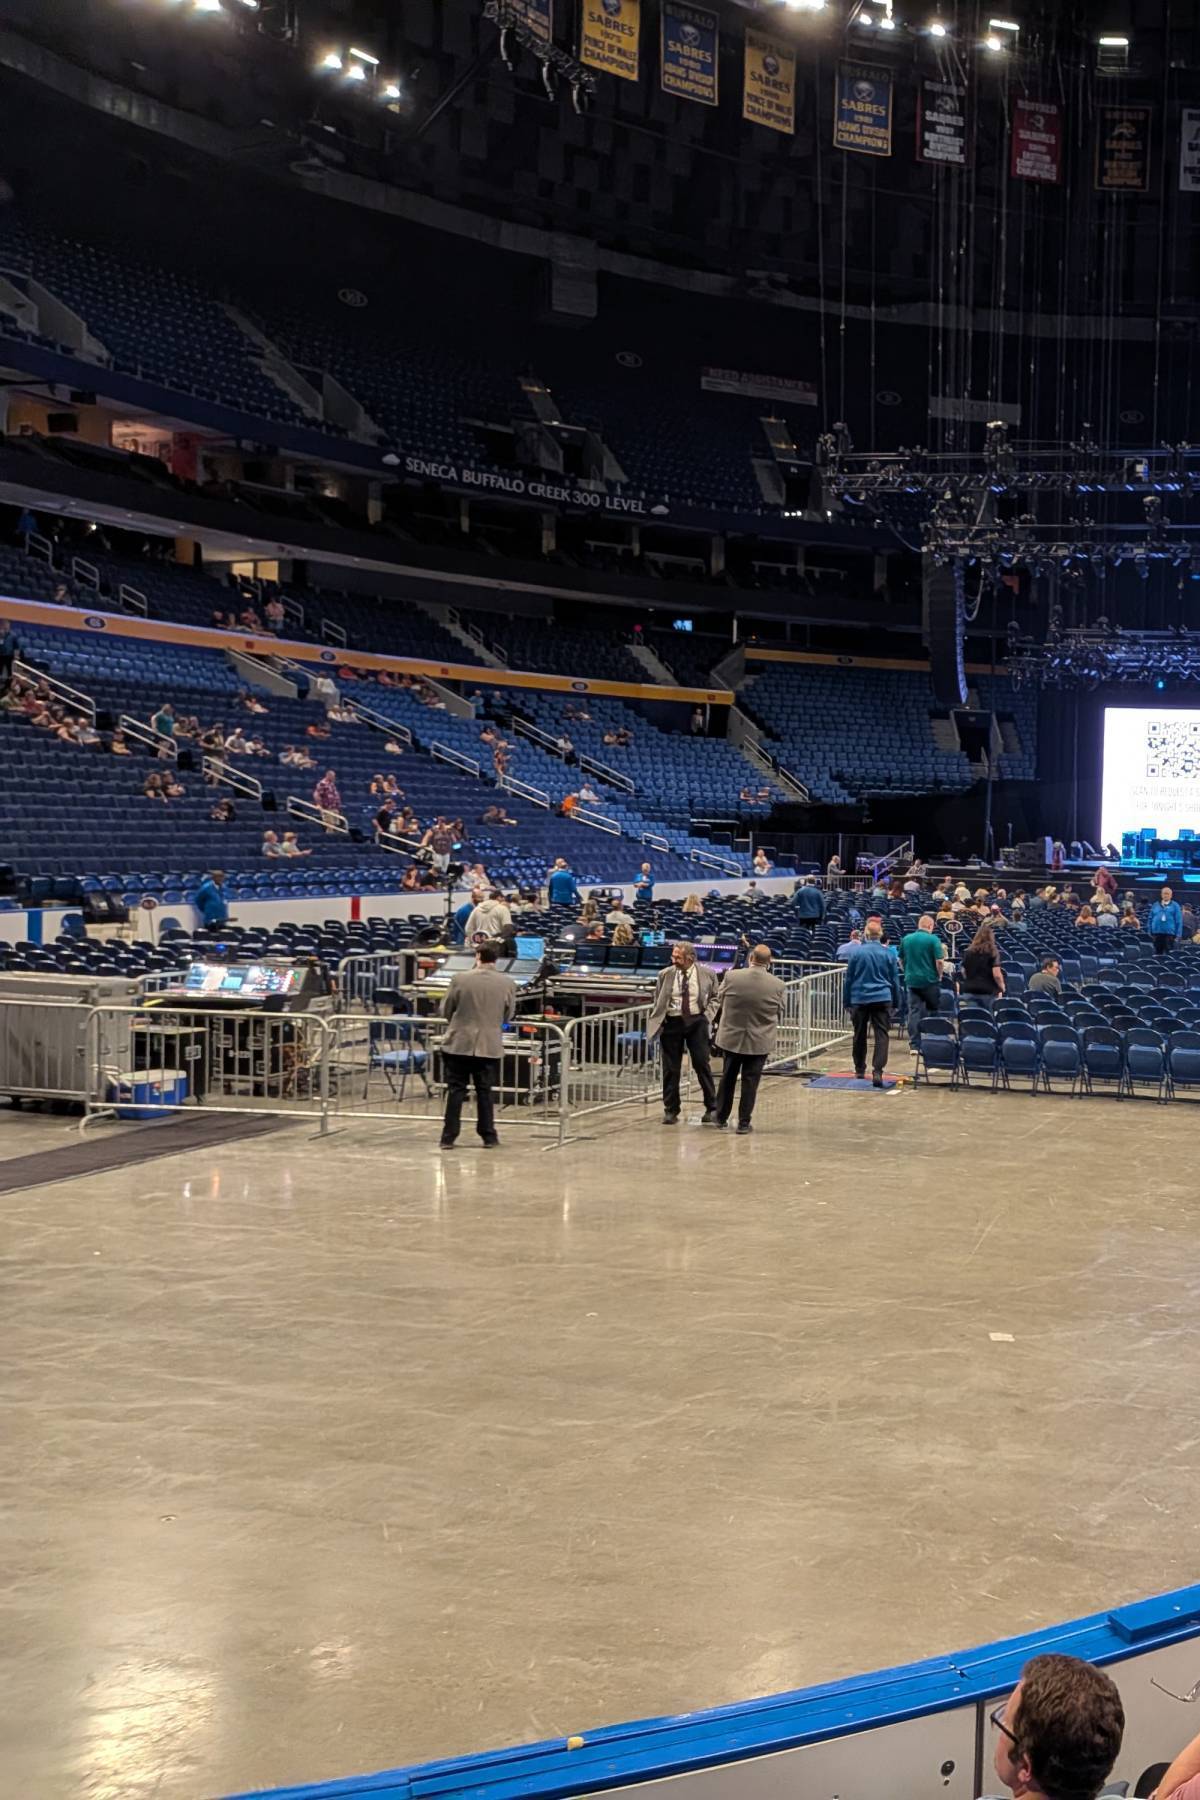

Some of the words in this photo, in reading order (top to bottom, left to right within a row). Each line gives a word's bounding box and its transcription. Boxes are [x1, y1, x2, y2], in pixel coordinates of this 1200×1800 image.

[588, 11, 635, 37] SABRES
[584, 48, 636, 73] CHAMPIONS
[668, 40, 712, 64] SABRES
[664, 74, 714, 98] CHAMPIONS
[750, 71, 792, 94] SABRES
[746, 104, 792, 128] CHAMPIONS
[841, 98, 887, 117] SABRES
[925, 110, 964, 127] SABRES
[838, 131, 888, 150] CHAMPIONS
[405, 457, 458, 482] SENECA
[462, 469, 526, 494] BUFFALO
[528, 482, 571, 502] CREEK
[572, 489, 600, 508] 300
[605, 496, 647, 514] LEVEL
